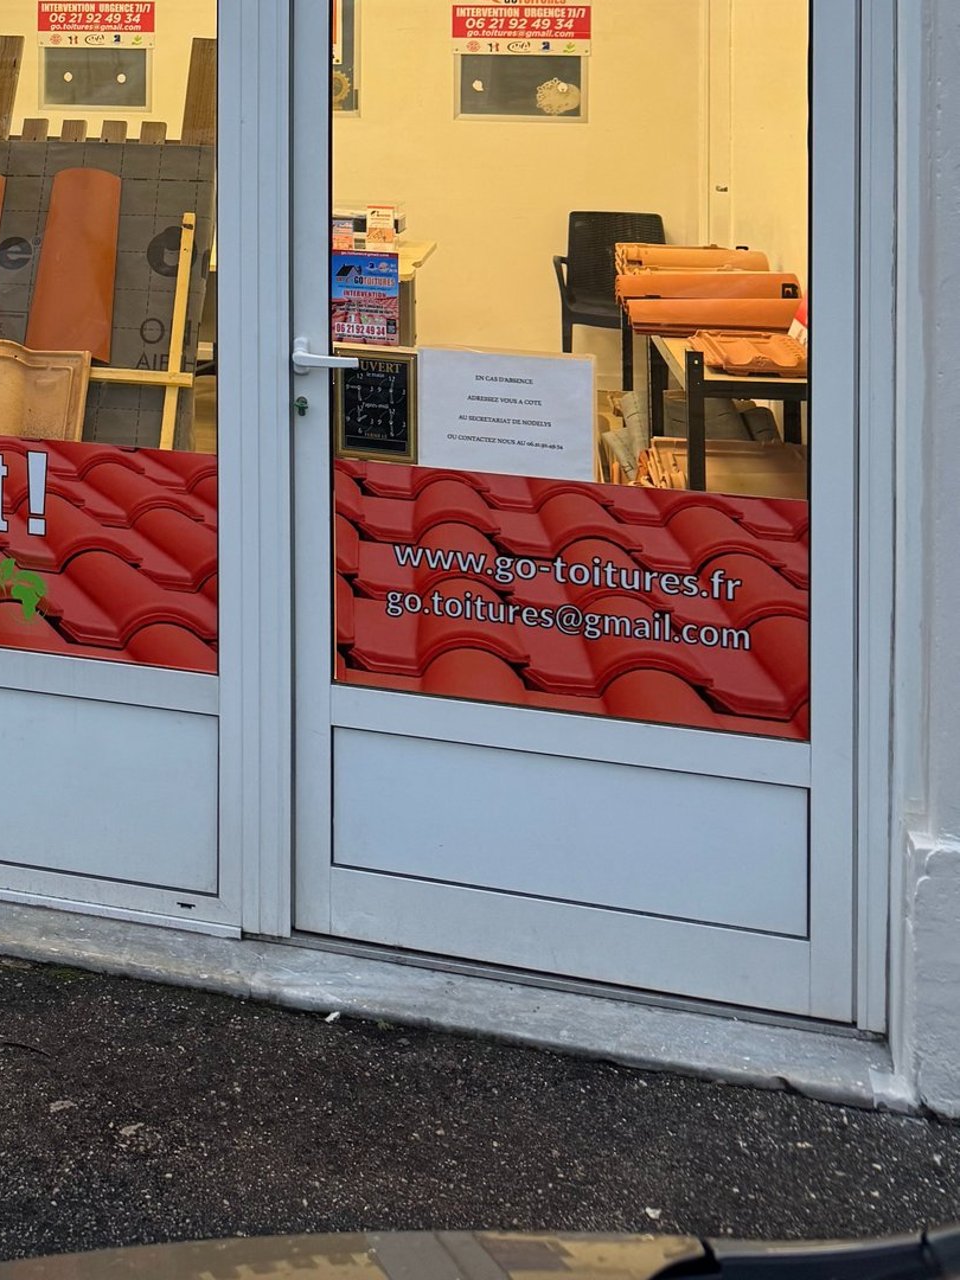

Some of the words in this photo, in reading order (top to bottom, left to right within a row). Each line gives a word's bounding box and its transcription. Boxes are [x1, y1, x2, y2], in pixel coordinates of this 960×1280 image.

[41, 3, 95, 12] INTERVENTION
[99, 4, 134, 13] URGENCE
[456, 8, 519, 17] INTERVENTION
[524, 8, 566, 18] URGENCE
[49, 13, 66, 23] 06
[69, 13, 82, 23] 21
[86, 13, 101, 23] 92
[104, 13, 121, 24] 49
[125, 13, 141, 24] 34
[465, 18, 485, 29] 06
[488, 18, 504, 29] 21
[508, 18, 527, 29] 92
[531, 18, 551, 29] 49
[554, 18, 574, 29] 34
[352, 361, 401, 373] UVERT
[458, 435, 496, 443] CONTACTEZ
[27, 451, 49, 536] !
[393, 543, 742, 601] www.go-toitures.fr
[386, 590, 751, 650] go.toitures@gmail.com
